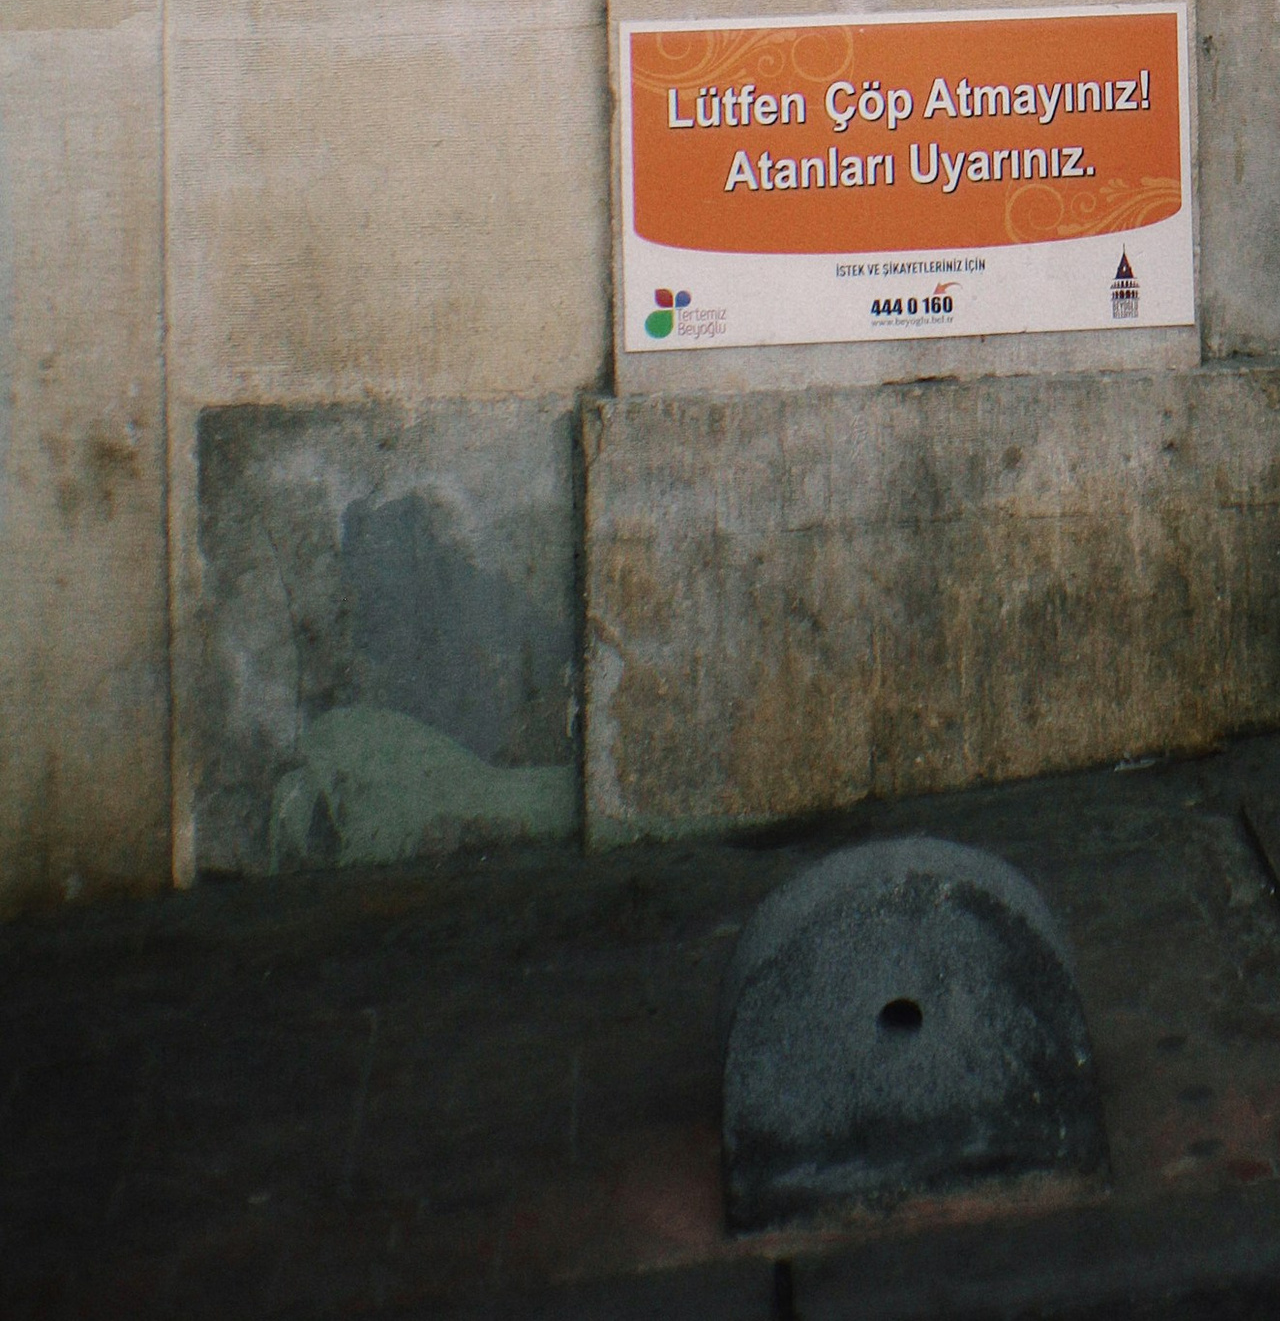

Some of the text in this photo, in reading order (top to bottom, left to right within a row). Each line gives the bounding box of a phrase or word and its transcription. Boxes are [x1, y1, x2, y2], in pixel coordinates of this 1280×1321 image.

[667, 69, 1151, 133] Lütfen Çöp Atmayınız!
[723, 142, 1096, 193] Atanları Uyarınız.
[836, 256, 986, 277] İSTEK VE ŞİKAYETLERİNİZ İÇİN
[678, 308, 727, 322] Tertemiz
[871, 295, 953, 317] 444 0 160
[678, 320, 727, 339] Beyoğlu
